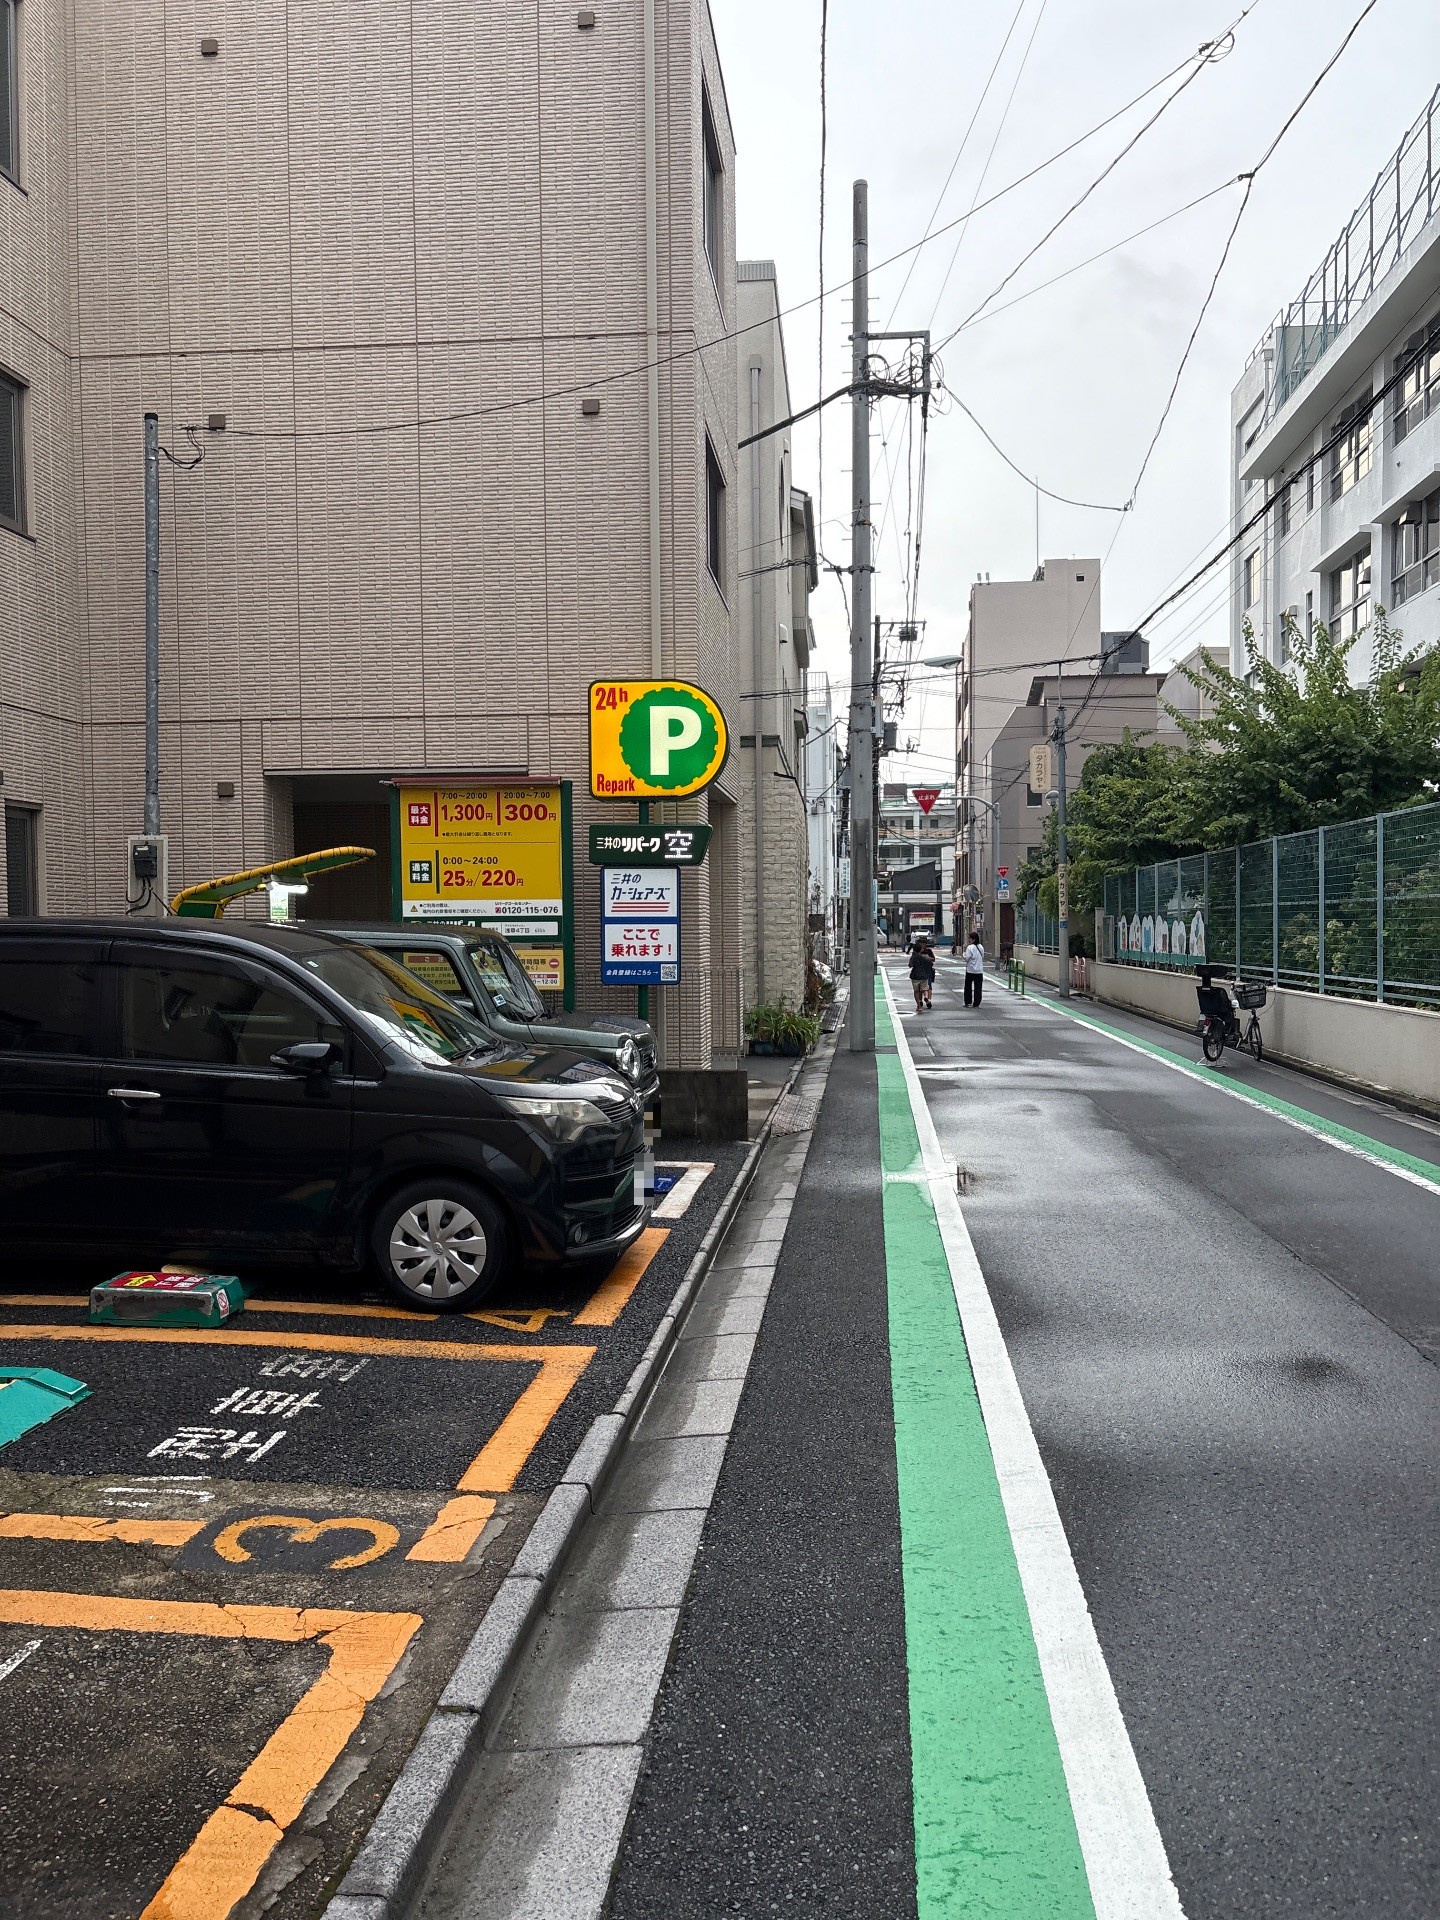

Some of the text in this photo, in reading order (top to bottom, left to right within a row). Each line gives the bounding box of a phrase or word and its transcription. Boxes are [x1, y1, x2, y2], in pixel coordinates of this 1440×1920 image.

[595, 687, 628, 711] 24h
[649, 705, 702, 776] P
[596, 773, 635, 794] Repark
[917, 793, 936, 801] 止まれ
[410, 805, 429, 815] 最大
[441, 803, 494, 822] 1,300円
[504, 803, 557, 822] 300円
[410, 815, 429, 825] 料金
[596, 830, 693, 859] 三井のリパーク 空
[411, 862, 430, 872] 通常
[411, 872, 430, 882] 料金
[610, 873, 642, 885] 三井の
[610, 885, 671, 901] カーシェアーズ
[622, 928, 661, 941] ここで
[213, 1514, 400, 1570] 3
